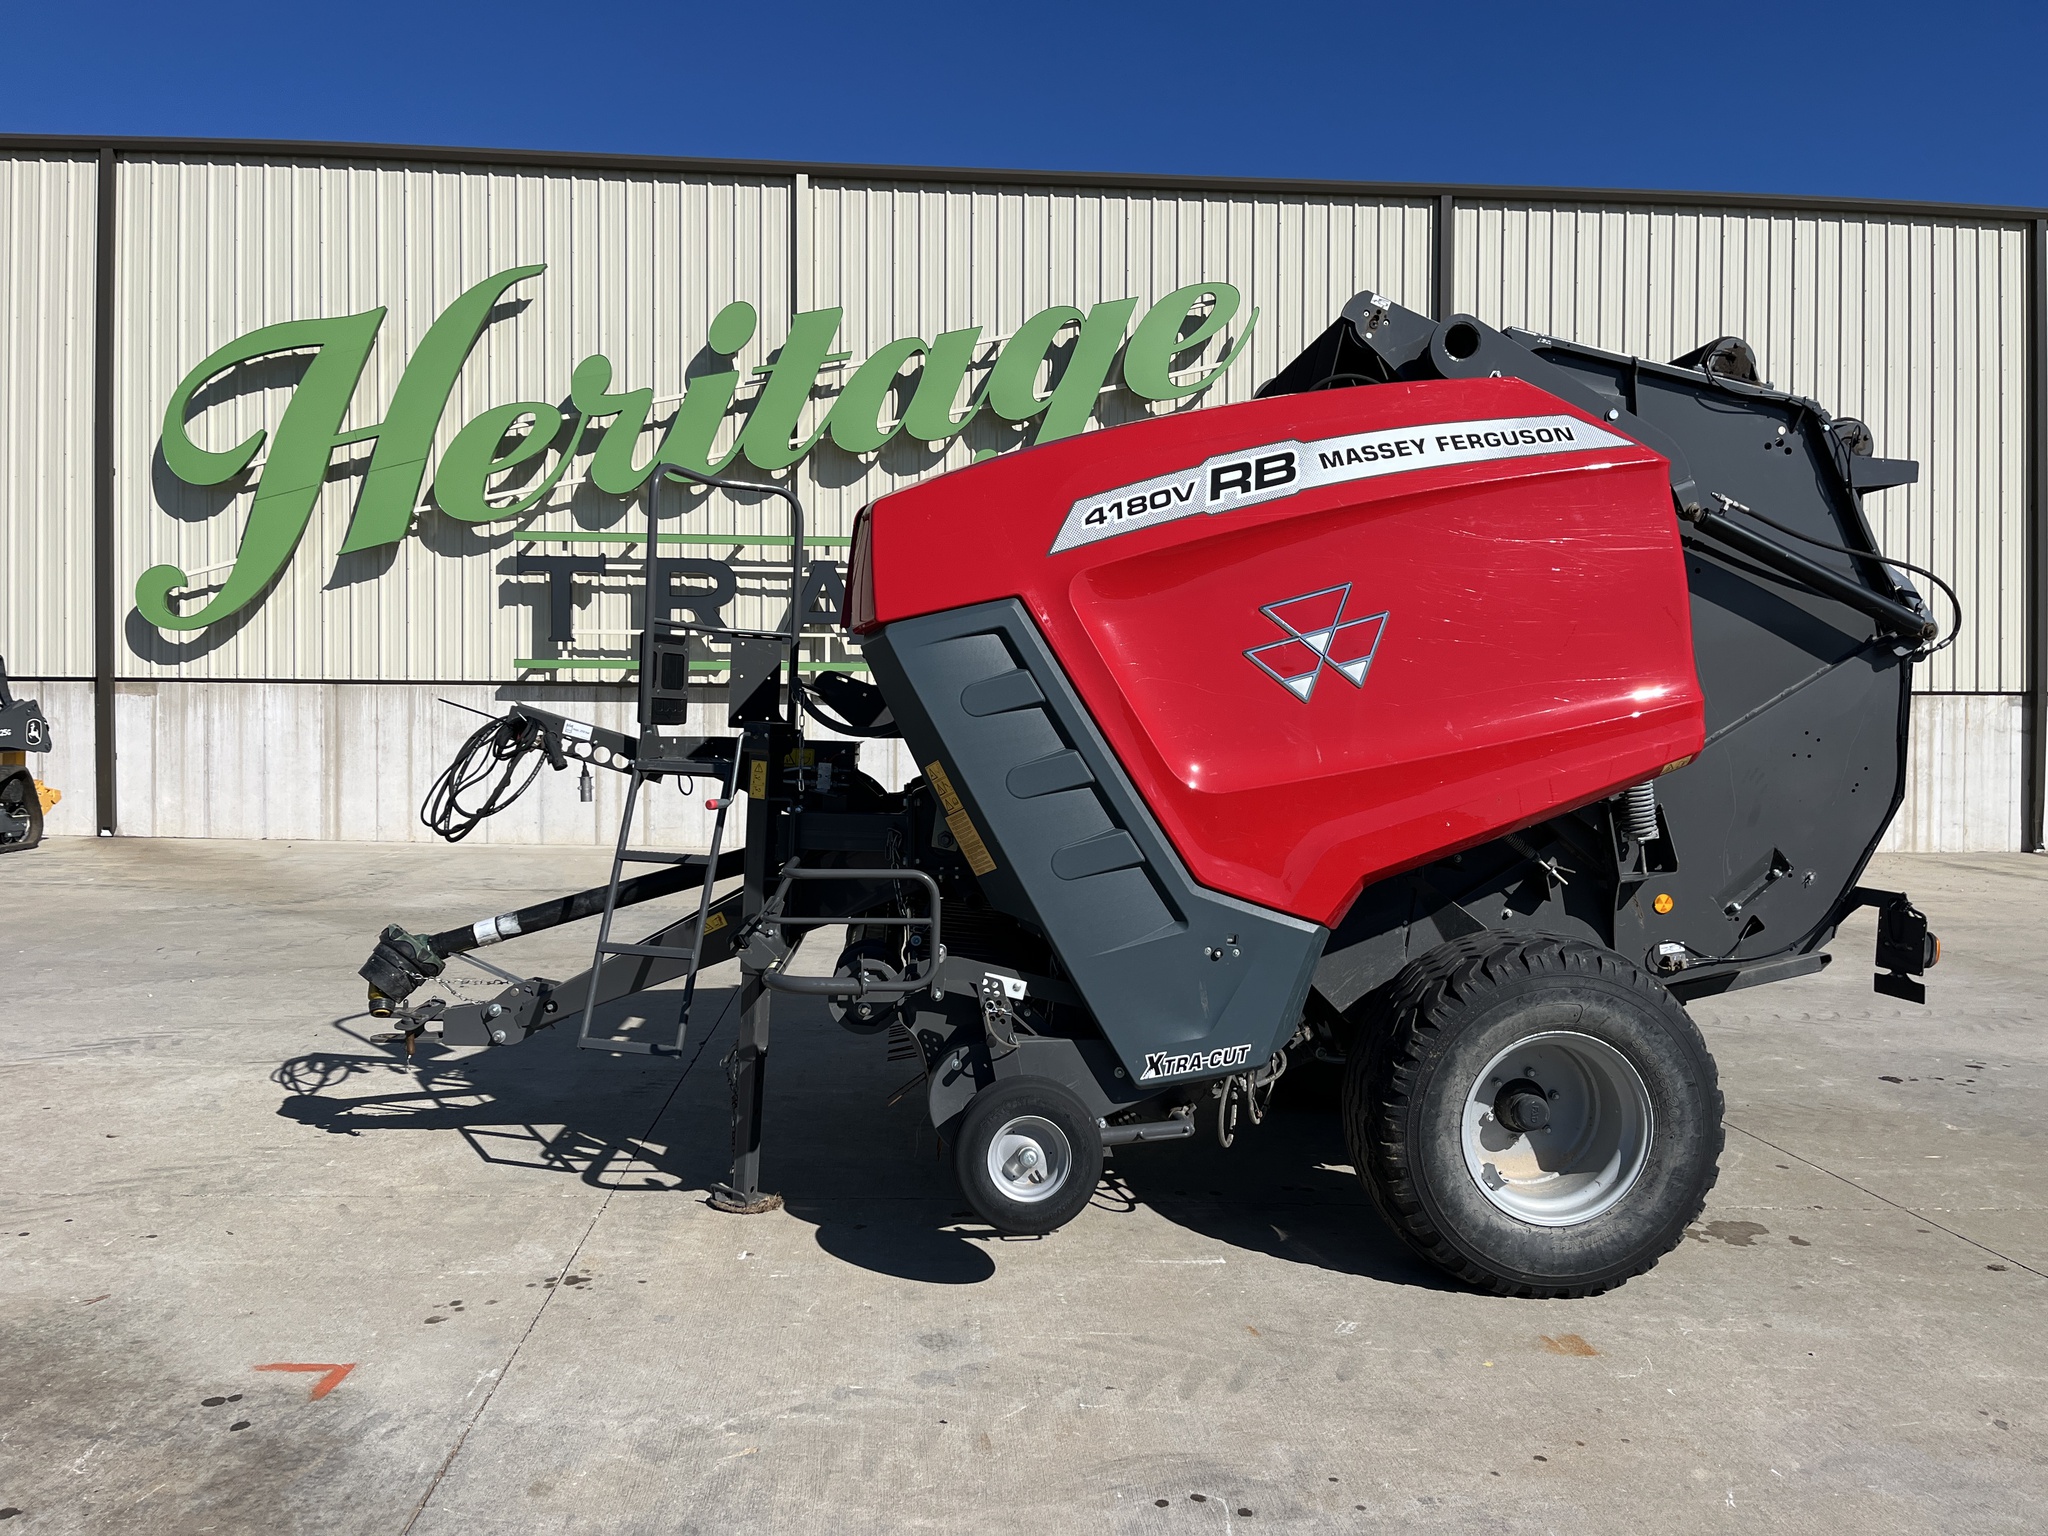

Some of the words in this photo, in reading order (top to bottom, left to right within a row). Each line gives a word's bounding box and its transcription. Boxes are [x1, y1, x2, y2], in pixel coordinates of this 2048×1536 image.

[135, 264, 1261, 631] Heritage
[1084, 482, 1197, 526] 4180V
[1209, 452, 1297, 502] RB
[1319, 438, 1426, 471] MASSEY
[1438, 426, 1575, 453] FERGUSON
[1140, 1044, 1251, 1078] XTRA-CUT
